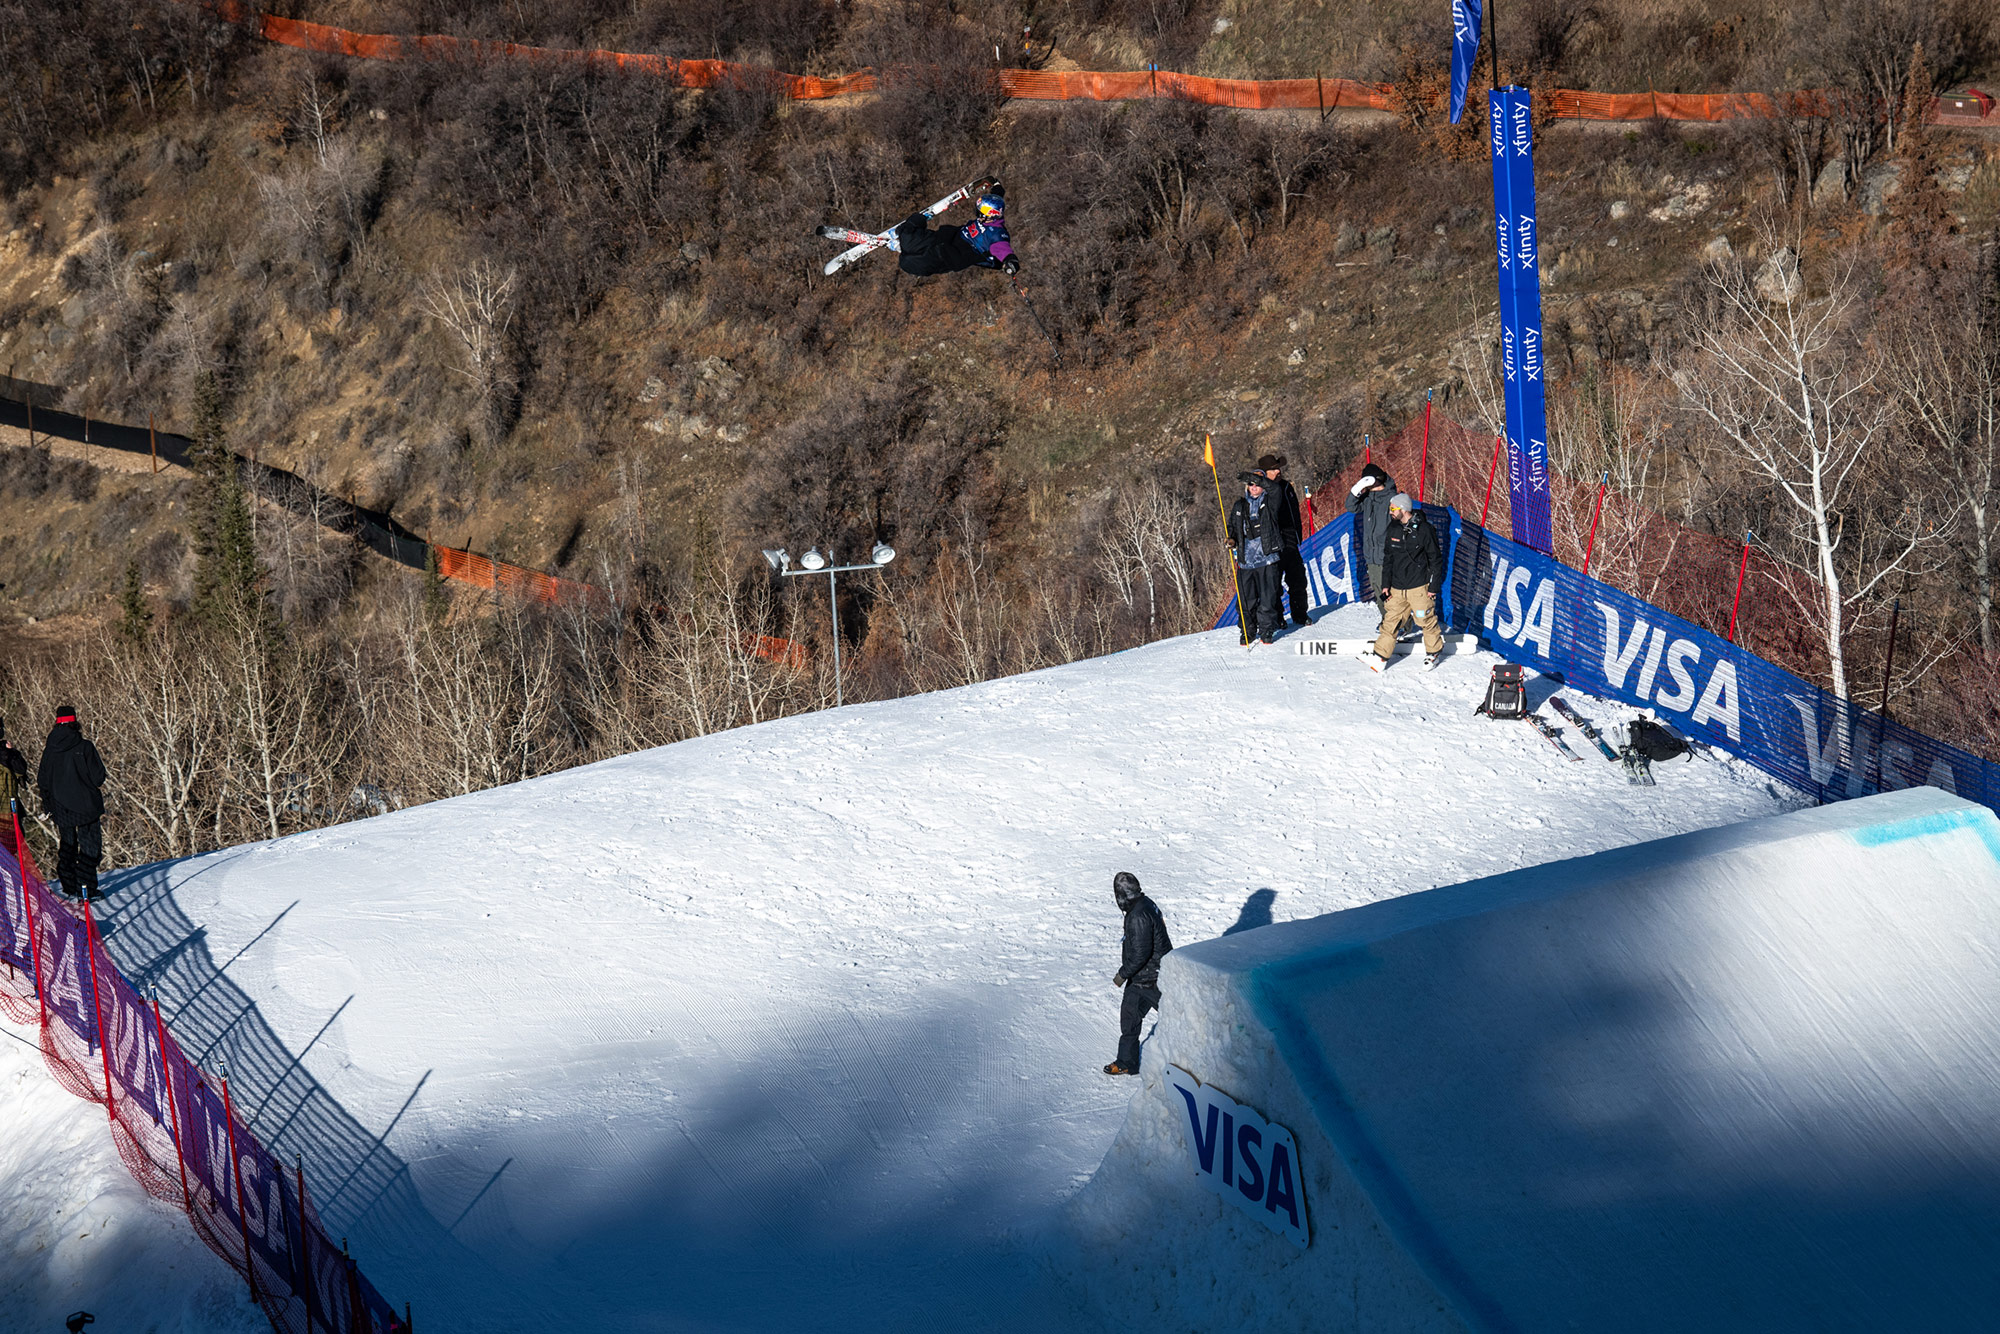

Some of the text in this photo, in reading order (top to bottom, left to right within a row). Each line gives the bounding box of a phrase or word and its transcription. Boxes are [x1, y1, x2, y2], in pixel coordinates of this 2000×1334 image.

[1492, 101, 1505, 158] xfinity
[1512, 101, 1529, 157] xfinity
[1498, 213, 1511, 270] xfinity
[1517, 214, 1536, 269] xfinity
[1503, 325, 1515, 382] xfinity
[1522, 326, 1541, 382] xfinity
[1509, 437, 1521, 493] xfinity
[1528, 438, 1546, 492] xfinity
[1299, 641, 1338, 655] LINE
[1594, 600, 1742, 743] VISA
[1494, 702, 1516, 711] CANADA
[195, 1093, 297, 1272] VISA
[1173, 1083, 1300, 1229] VISA
